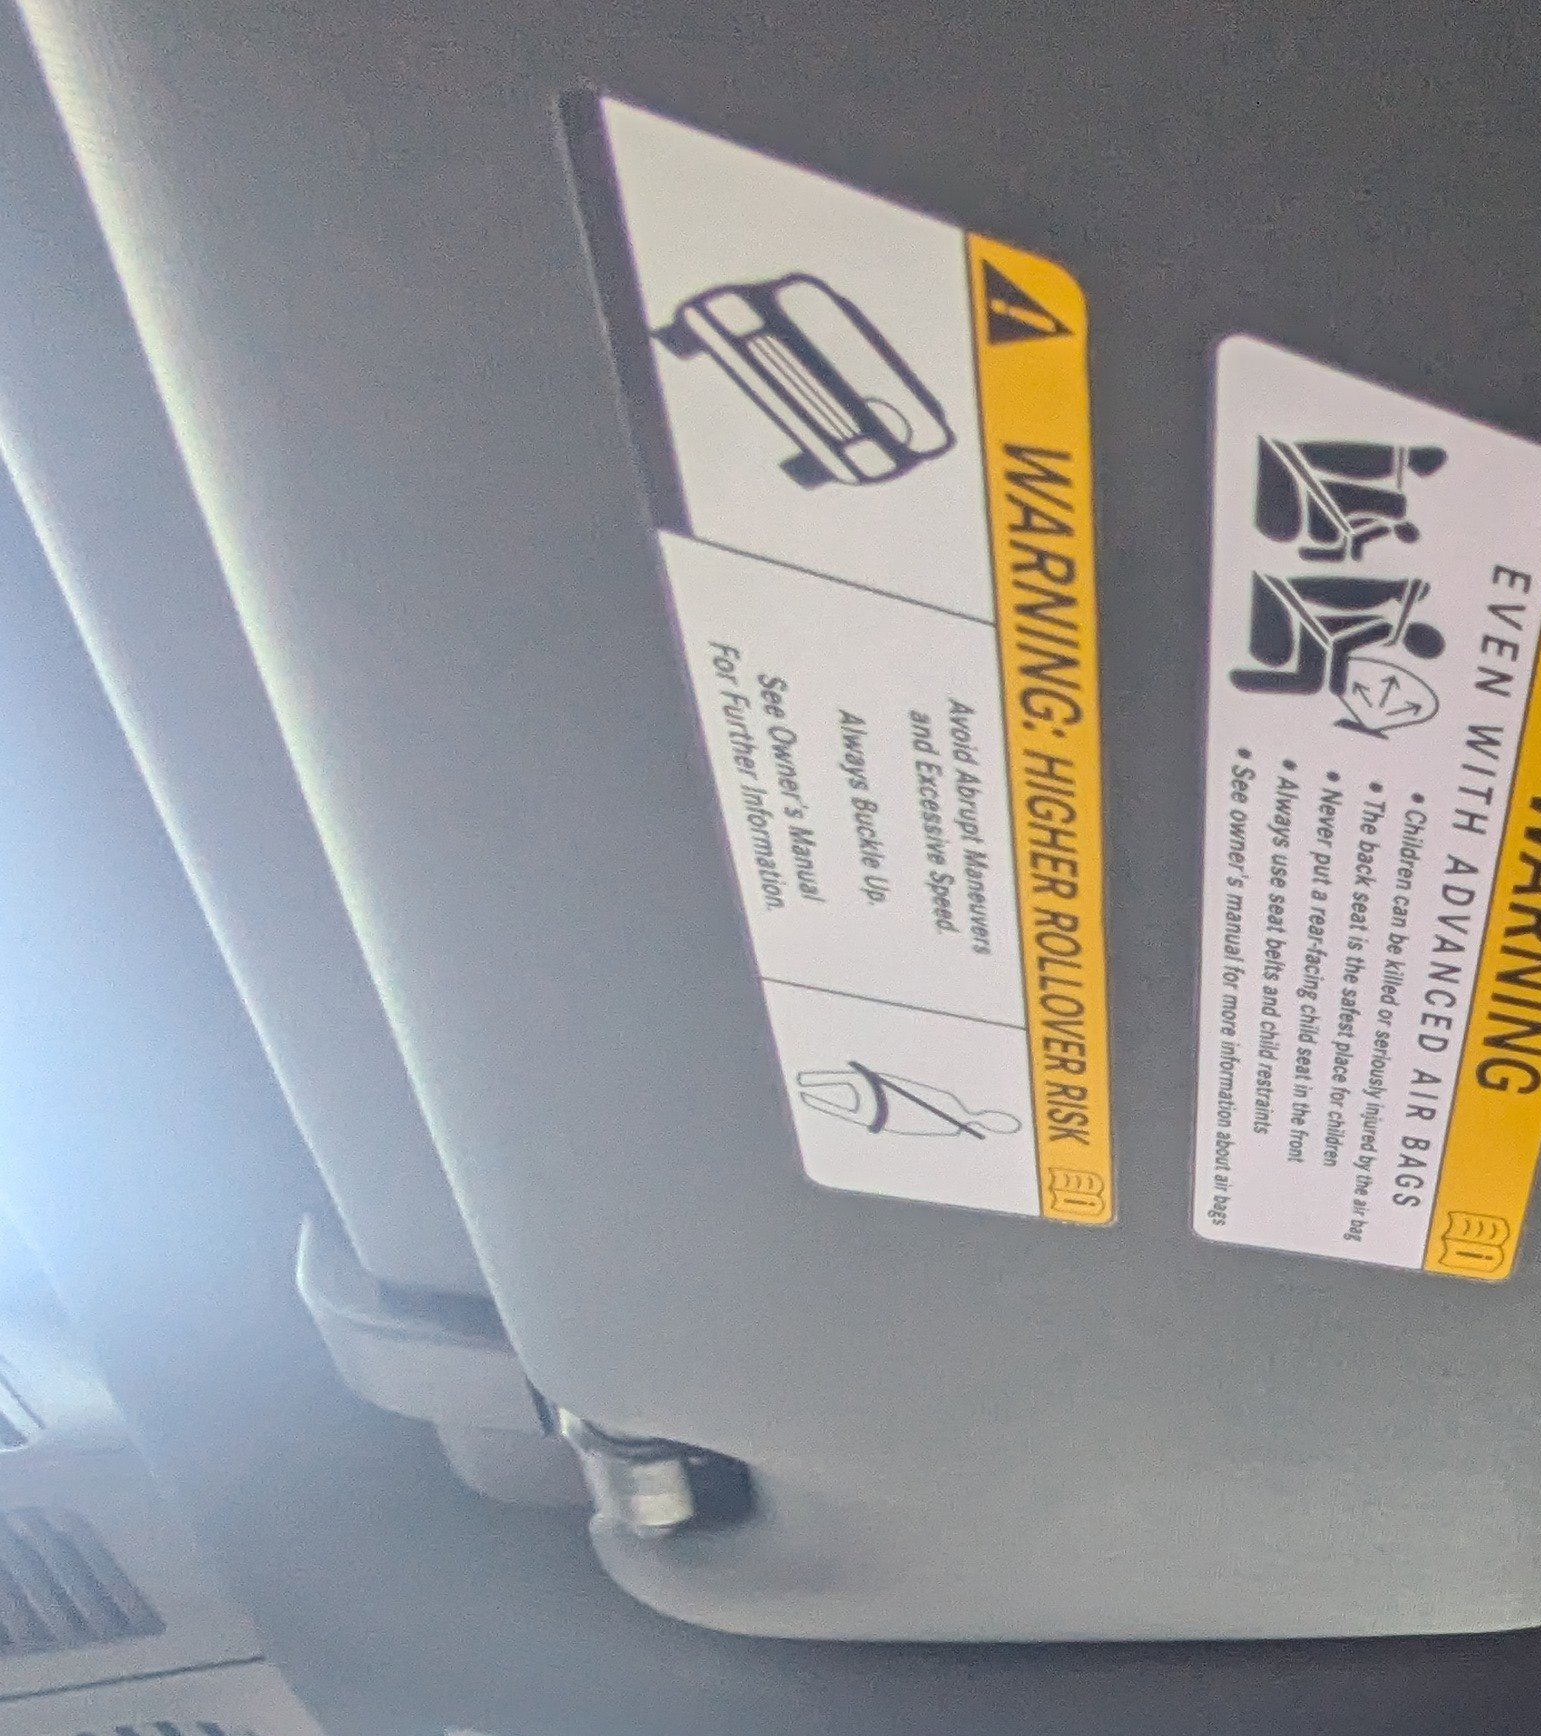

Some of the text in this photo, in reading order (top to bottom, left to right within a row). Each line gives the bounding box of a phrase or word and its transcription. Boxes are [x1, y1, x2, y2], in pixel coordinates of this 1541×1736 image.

[708, 641, 740, 685] For
[720, 691, 759, 781] Further
[757, 672, 825, 902] See Owner's Manual
[839, 709, 869, 791] Always
[908, 710, 940, 755] and
[851, 797, 885, 869] Buckle
[915, 760, 949, 865] Excessive
[948, 697, 991, 955] Avoid Abrupt Maneuvers
[1003, 443, 1091, 1147] WARNING: HIGHER ROLLOVER RISK
[1392, 564, 1532, 1207] EVEN WITH ADVANCED AIR BAGS
[1207, 765, 1256, 1226] See owner's manual for more information about air bags
[1253, 776, 1299, 1134] Always use seat belts and child restraints
[1288, 787, 1343, 1163] Never put a rear-facing child seat in the front
[1323, 801, 1386, 1167] The back seat is the safest place for children
[1343, 809, 1427, 1242] Children can be killed or seriously injured by the air bag
